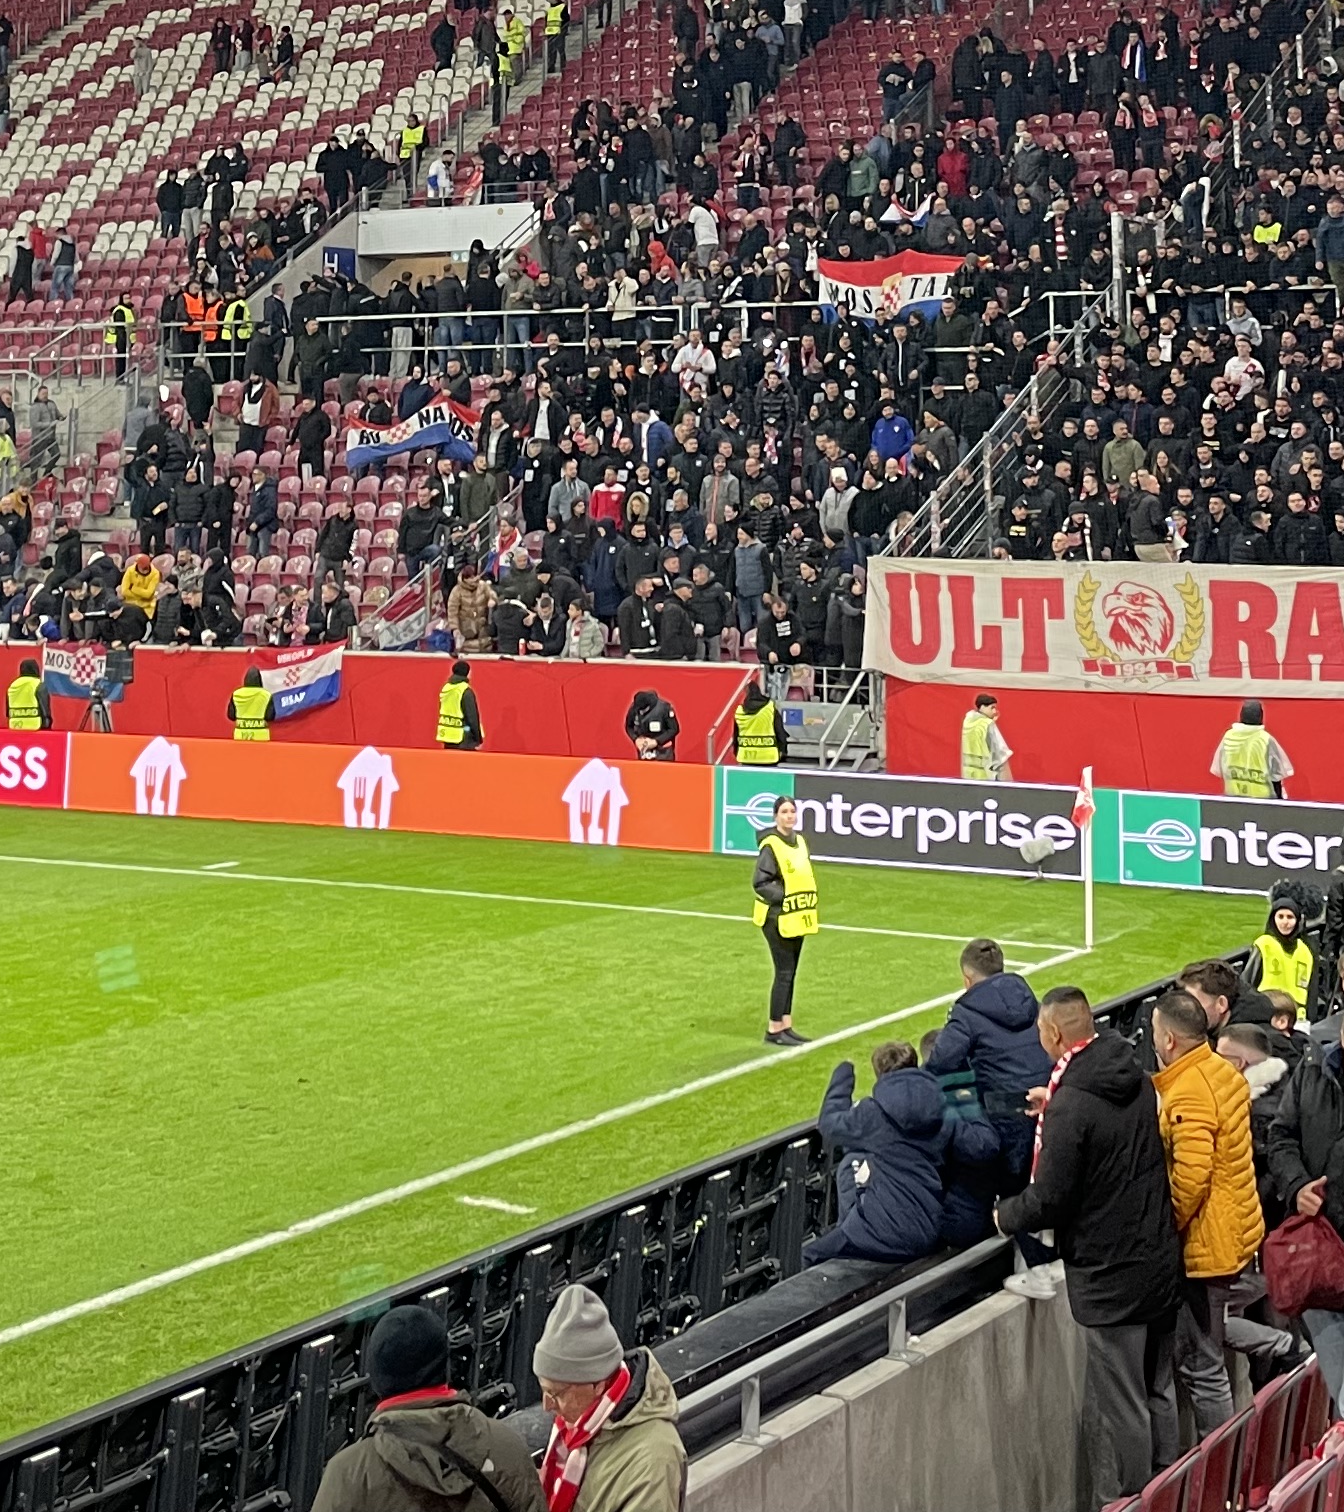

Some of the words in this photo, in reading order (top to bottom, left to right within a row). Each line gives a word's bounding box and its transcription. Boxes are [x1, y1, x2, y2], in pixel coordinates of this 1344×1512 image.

[885, 572, 1066, 672] ULT
[45, 651, 72, 670] MOS
[1116, 661, 1158, 677] 1994
[746, 792, 1077, 854] enterprise
